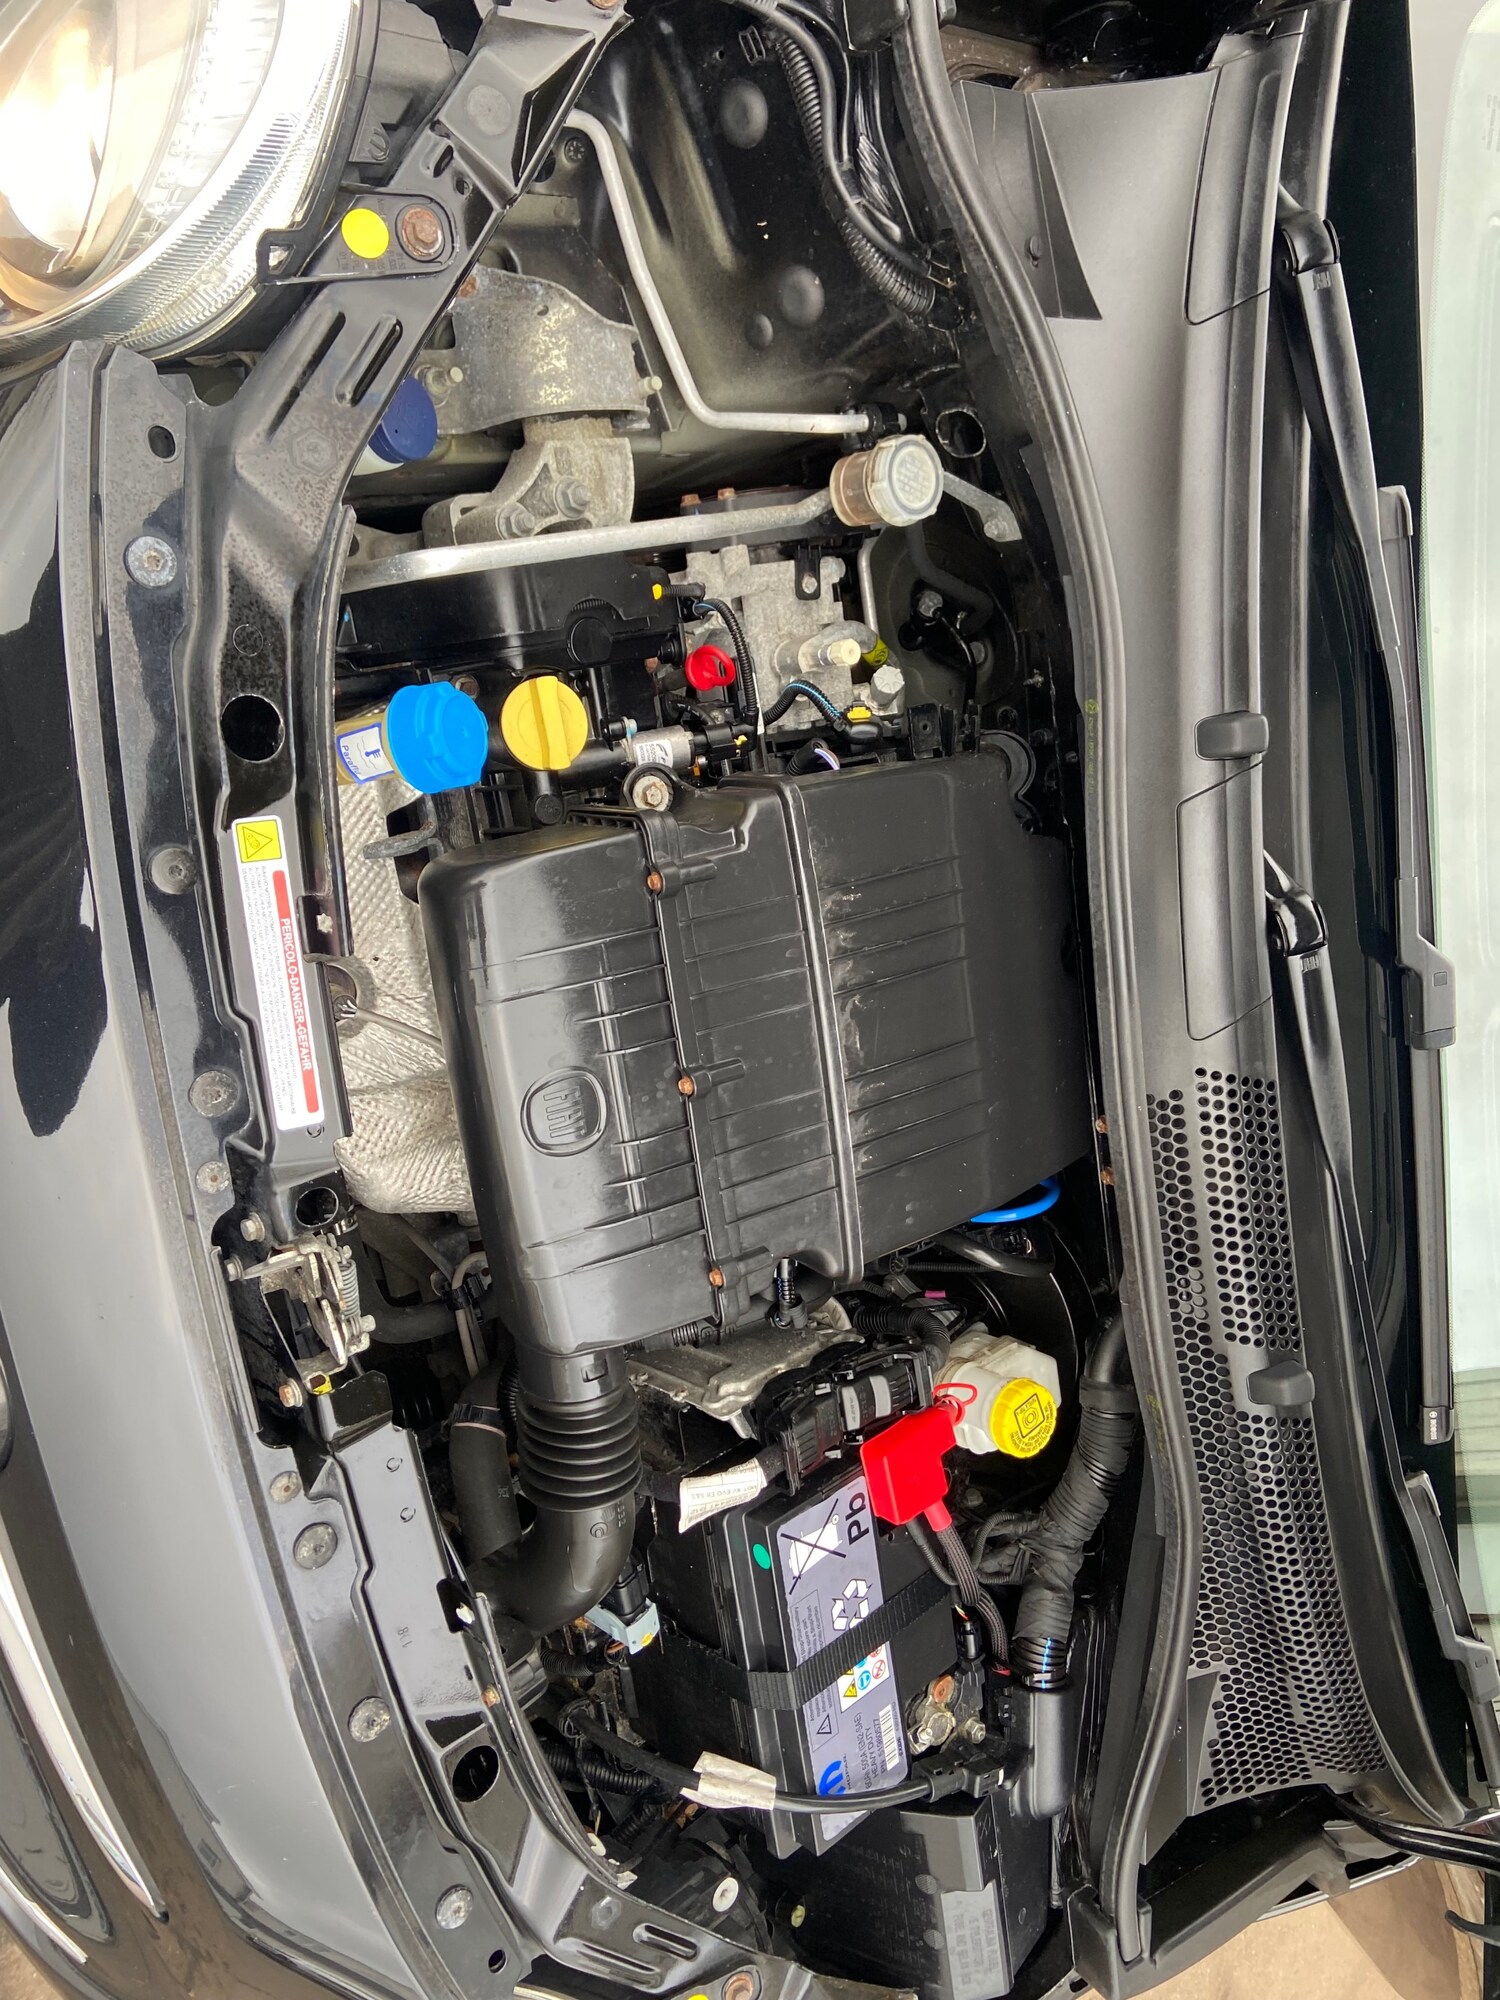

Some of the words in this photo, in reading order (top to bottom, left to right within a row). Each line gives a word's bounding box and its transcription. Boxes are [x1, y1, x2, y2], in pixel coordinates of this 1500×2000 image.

[279, 917, 312, 1071] PERICOLO-DANGER-GEFAHR
[542, 1086, 587, 1139] FIAT
[845, 1492, 869, 1545] Pb
[864, 1725, 874, 1750] DUTY
[868, 1748, 879, 1778] HEAVY
